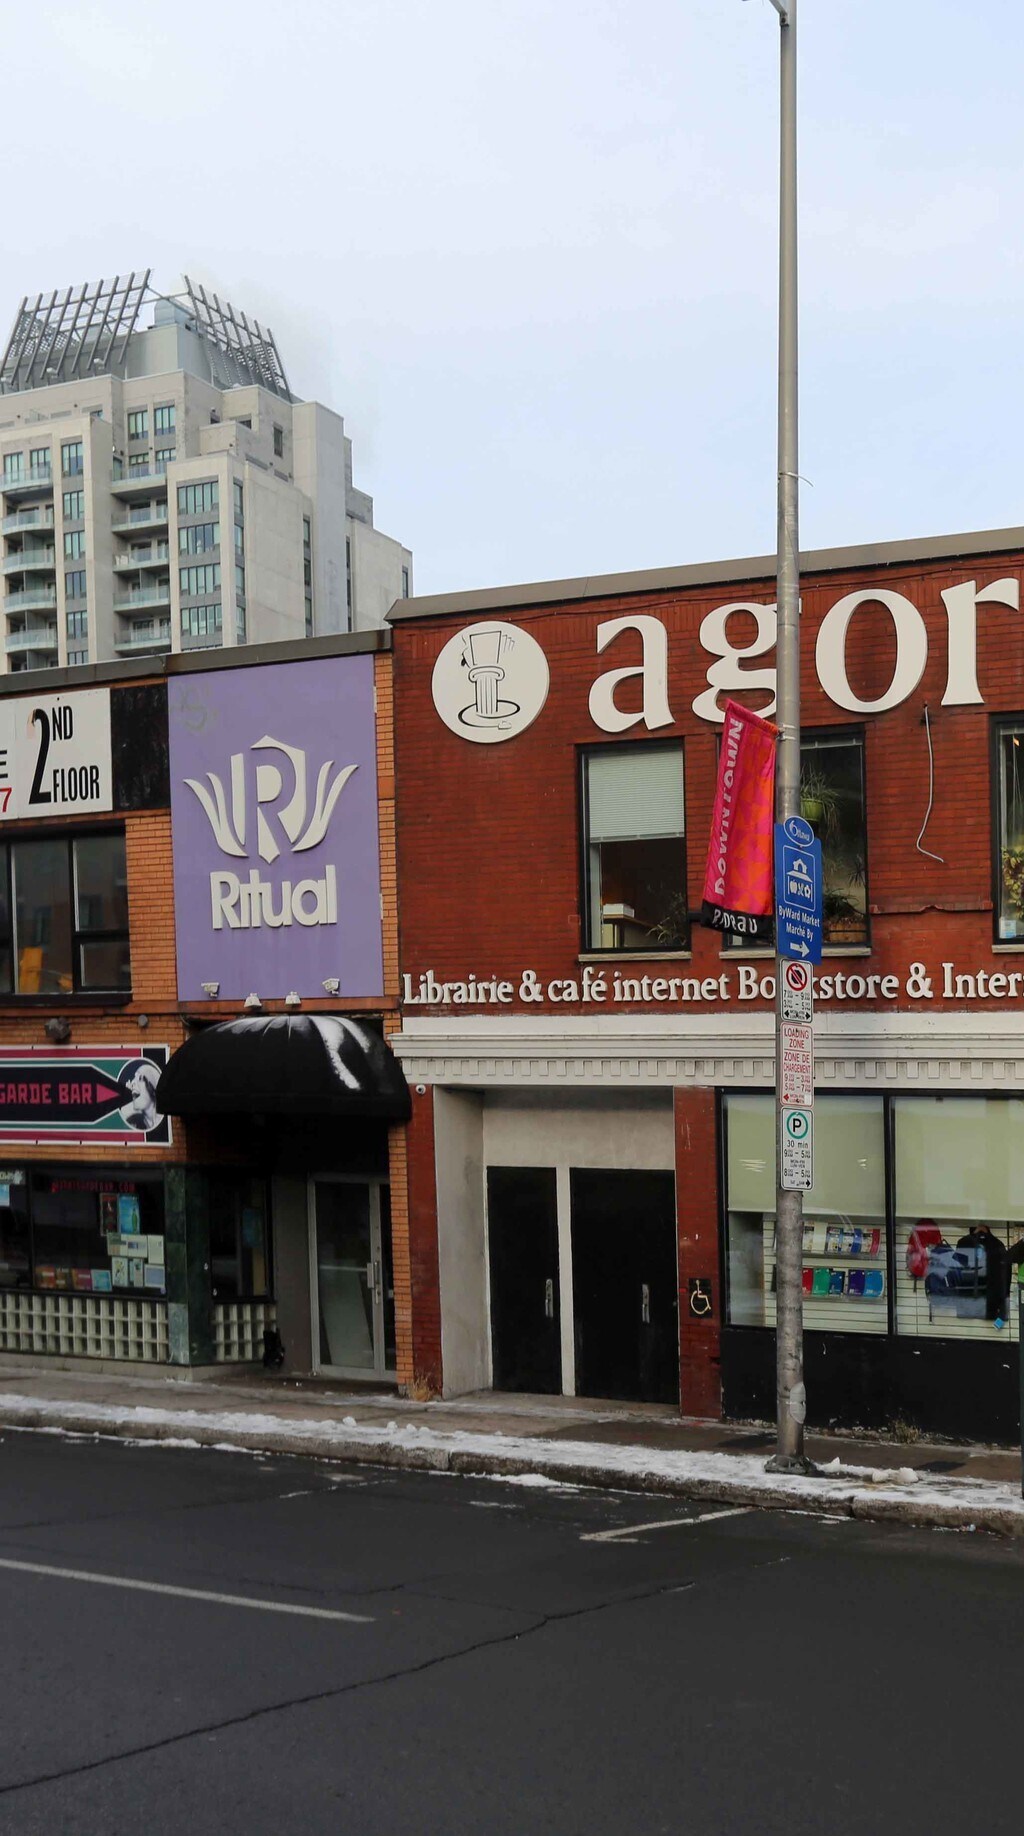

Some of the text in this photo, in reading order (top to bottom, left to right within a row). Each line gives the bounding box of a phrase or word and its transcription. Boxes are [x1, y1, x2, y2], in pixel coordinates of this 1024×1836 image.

[53, 765, 100, 803] FLOOR
[209, 864, 338, 930] Ritual
[779, 905, 820, 928] ByWard Market
[806, 928, 814, 943] By
[403, 970, 514, 1005] Librairie
[519, 969, 544, 1003] &
[547, 966, 607, 1003] café
[613, 970, 730, 1002] internet
[737, 965, 900, 1001] Bostore
[906, 962, 934, 999] &
[784, 1028, 810, 1040] LOADING
[789, 1038, 805, 1049] ZONE
[784, 1051, 810, 1064] ZONE DE
[59, 1083, 93, 1104] BAR
[792, 1118, 802, 1132] P
[787, 1140, 795, 1148] 30
